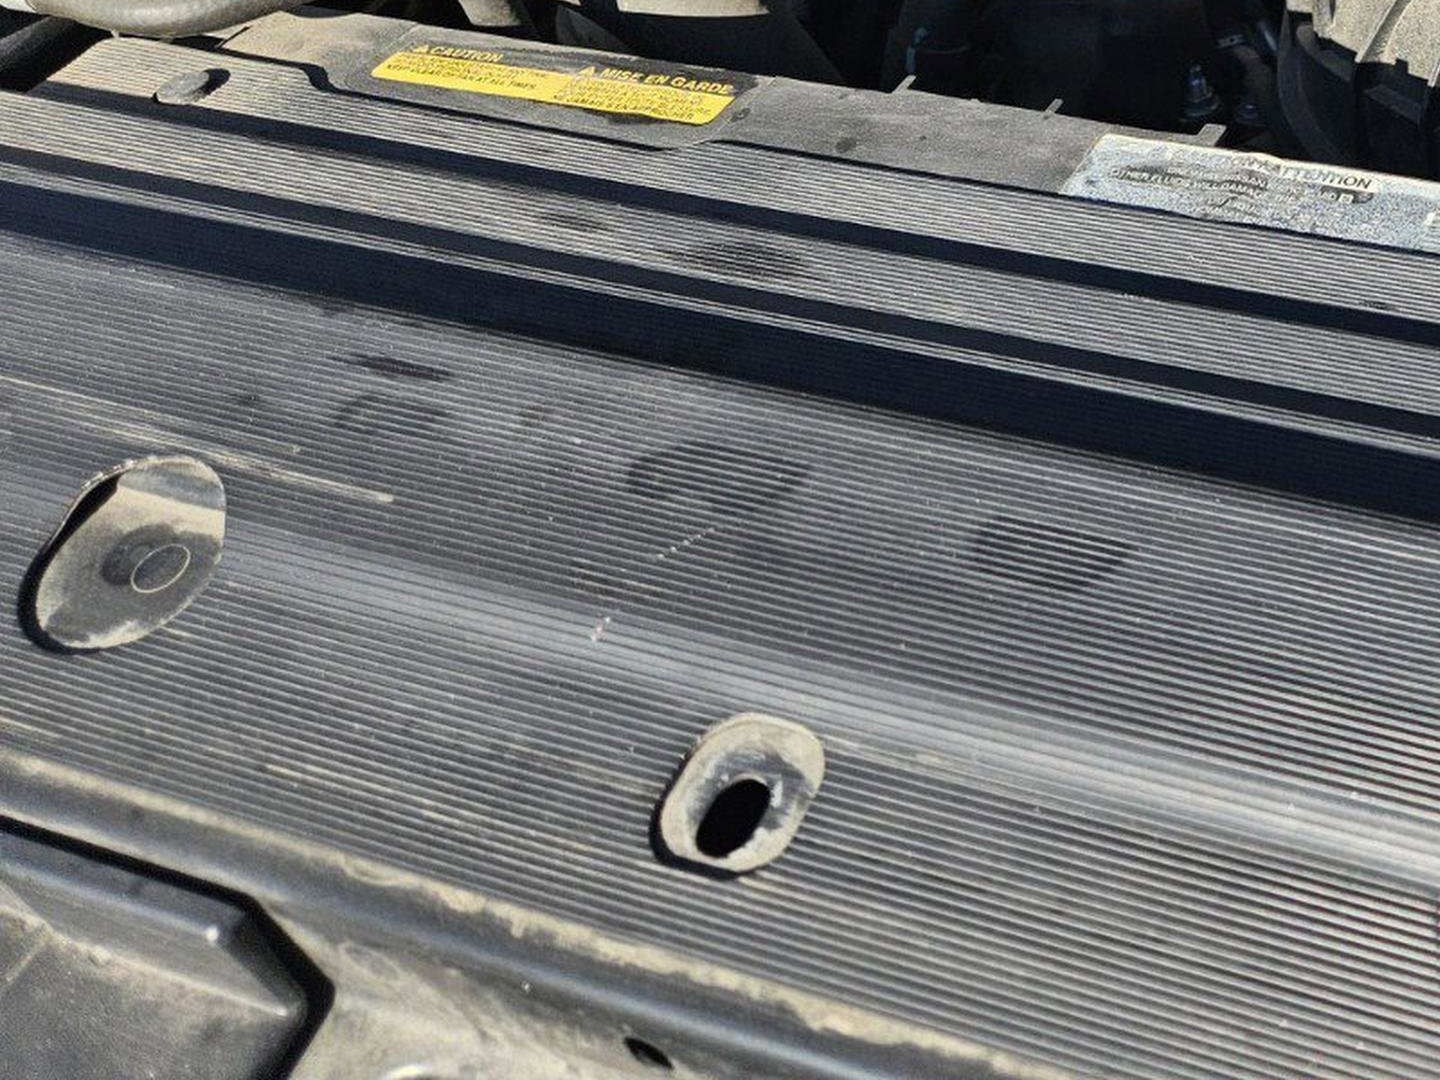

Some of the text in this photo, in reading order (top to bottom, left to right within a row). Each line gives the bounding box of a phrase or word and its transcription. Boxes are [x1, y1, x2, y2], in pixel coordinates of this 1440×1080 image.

[430, 46, 503, 62] CAUTION
[601, 67, 736, 95] MISE EN GARDE
